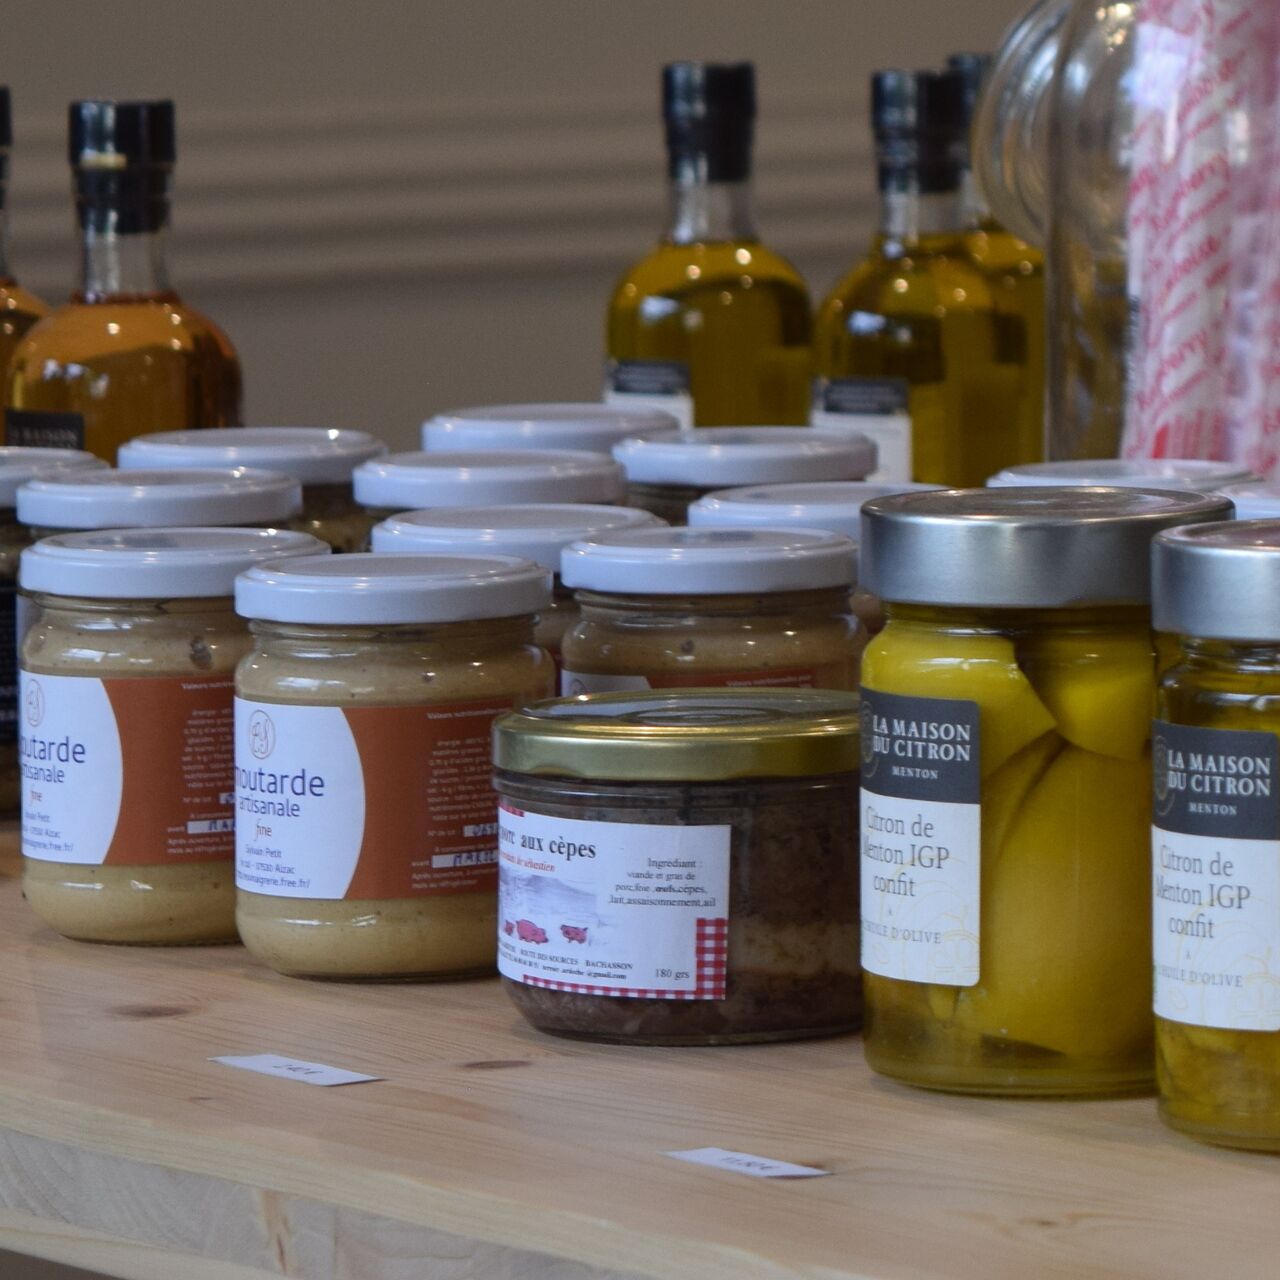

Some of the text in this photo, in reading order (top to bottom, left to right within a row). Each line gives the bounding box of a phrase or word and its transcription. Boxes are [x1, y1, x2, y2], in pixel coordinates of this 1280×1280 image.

[872, 715, 972, 742] LA MAISON
[872, 735, 972, 762] DU CITRON
[892, 765, 939, 780] MENTON
[1167, 749, 1272, 775] LA MAISON
[1167, 771, 1272, 797] DU CITRON
[865, 806, 934, 839] Citron de
[1188, 802, 1238, 817] MENTON
[253, 819, 273, 843] fine
[264, 846, 282, 859] Petit
[519, 832, 545, 852] aux
[548, 836, 598, 862] cèpes
[909, 843, 951, 870] IGP
[1159, 844, 1234, 877] Citron de
[685, 872, 696, 881] de
[872, 871, 916, 898] confit
[1209, 883, 1251, 910] IGP
[891, 923, 942, 945] D'OLIVE
[1168, 912, 1216, 939] confit
[655, 968, 691, 982] 180 grs
[1188, 968, 1244, 989] D'OLIVE
